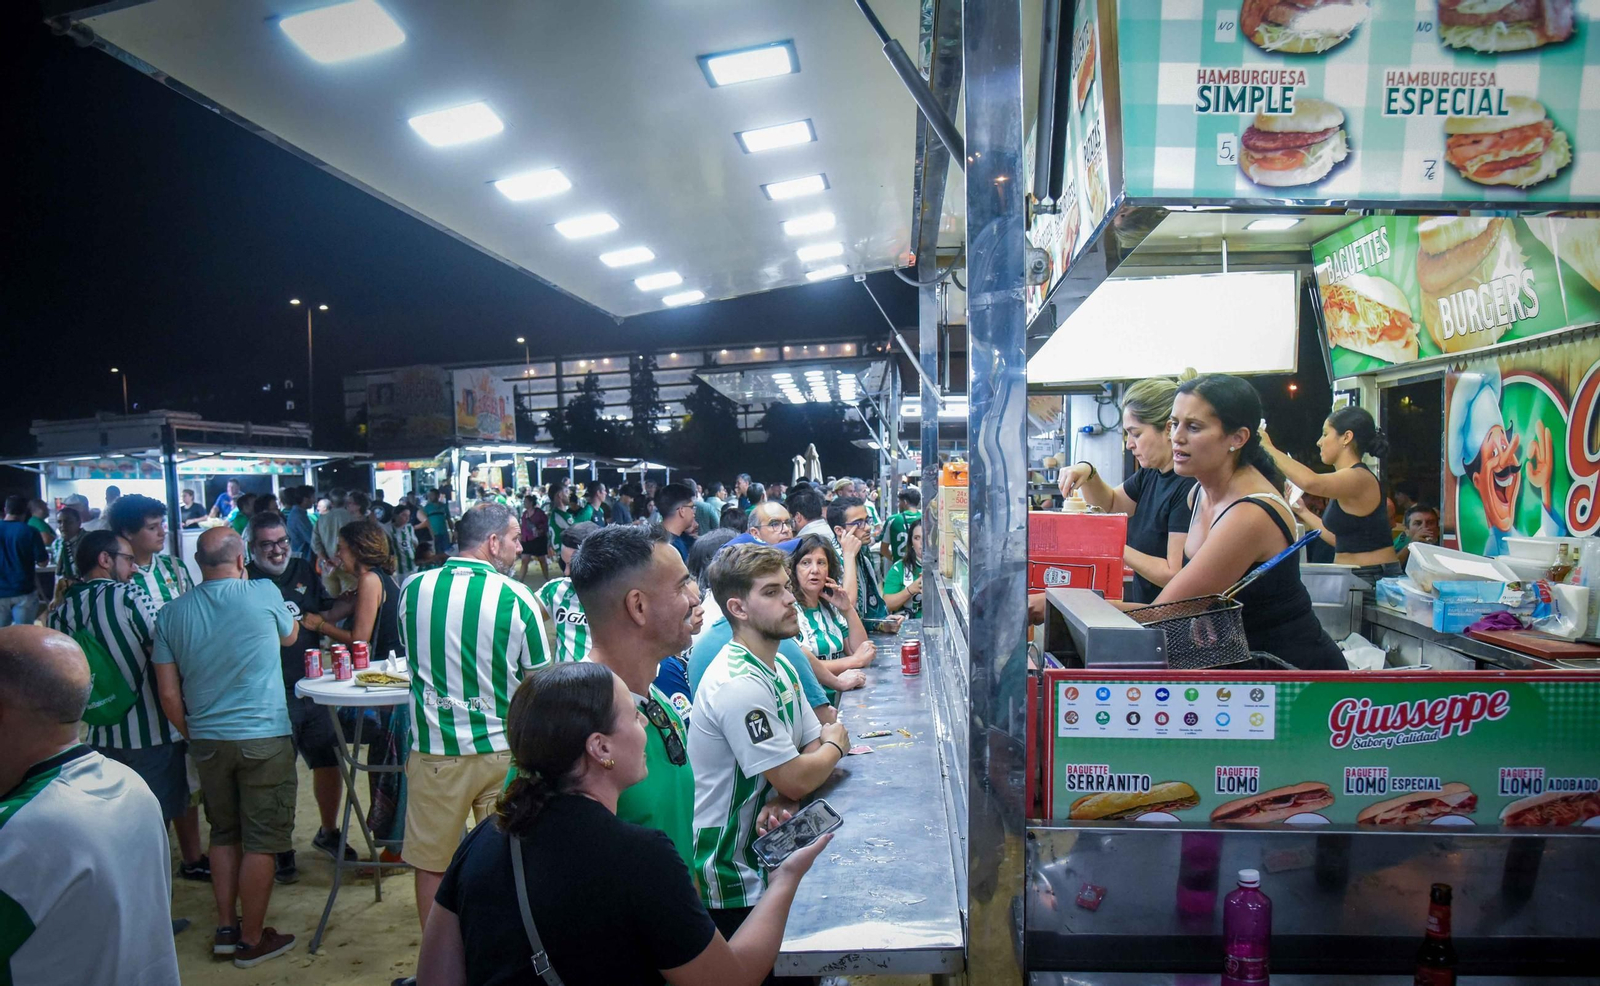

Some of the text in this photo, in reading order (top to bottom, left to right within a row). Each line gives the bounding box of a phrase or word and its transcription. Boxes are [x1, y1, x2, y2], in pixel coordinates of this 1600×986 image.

[1217, 22, 1234, 31] NO
[1415, 22, 1433, 32] NO
[1196, 69, 1306, 85] HAMBURGUESA
[1385, 71, 1497, 87] HAMBURGUESA
[1195, 85, 1294, 113] SIMPLE
[1384, 87, 1509, 116] ESPECIAL
[1325, 226, 1390, 286] BAGUETTES
[1437, 268, 1541, 340] BURGERS
[1330, 690, 1509, 748] Giusseppe
[1353, 731, 1438, 749] Sabor y Calidad
[1067, 765, 1108, 774] BAGUETTE
[1217, 767, 1258, 776] BAGUETTE
[1345, 768, 1388, 777] BAGUETTE
[1501, 769, 1543, 778] BAGUETTE
[1067, 774, 1150, 792] SERRANITO
[1217, 776, 1258, 793] LOMO
[1345, 777, 1442, 794] LOMO ESPECIAL
[1501, 777, 1599, 795] LOMO ADOBADO
